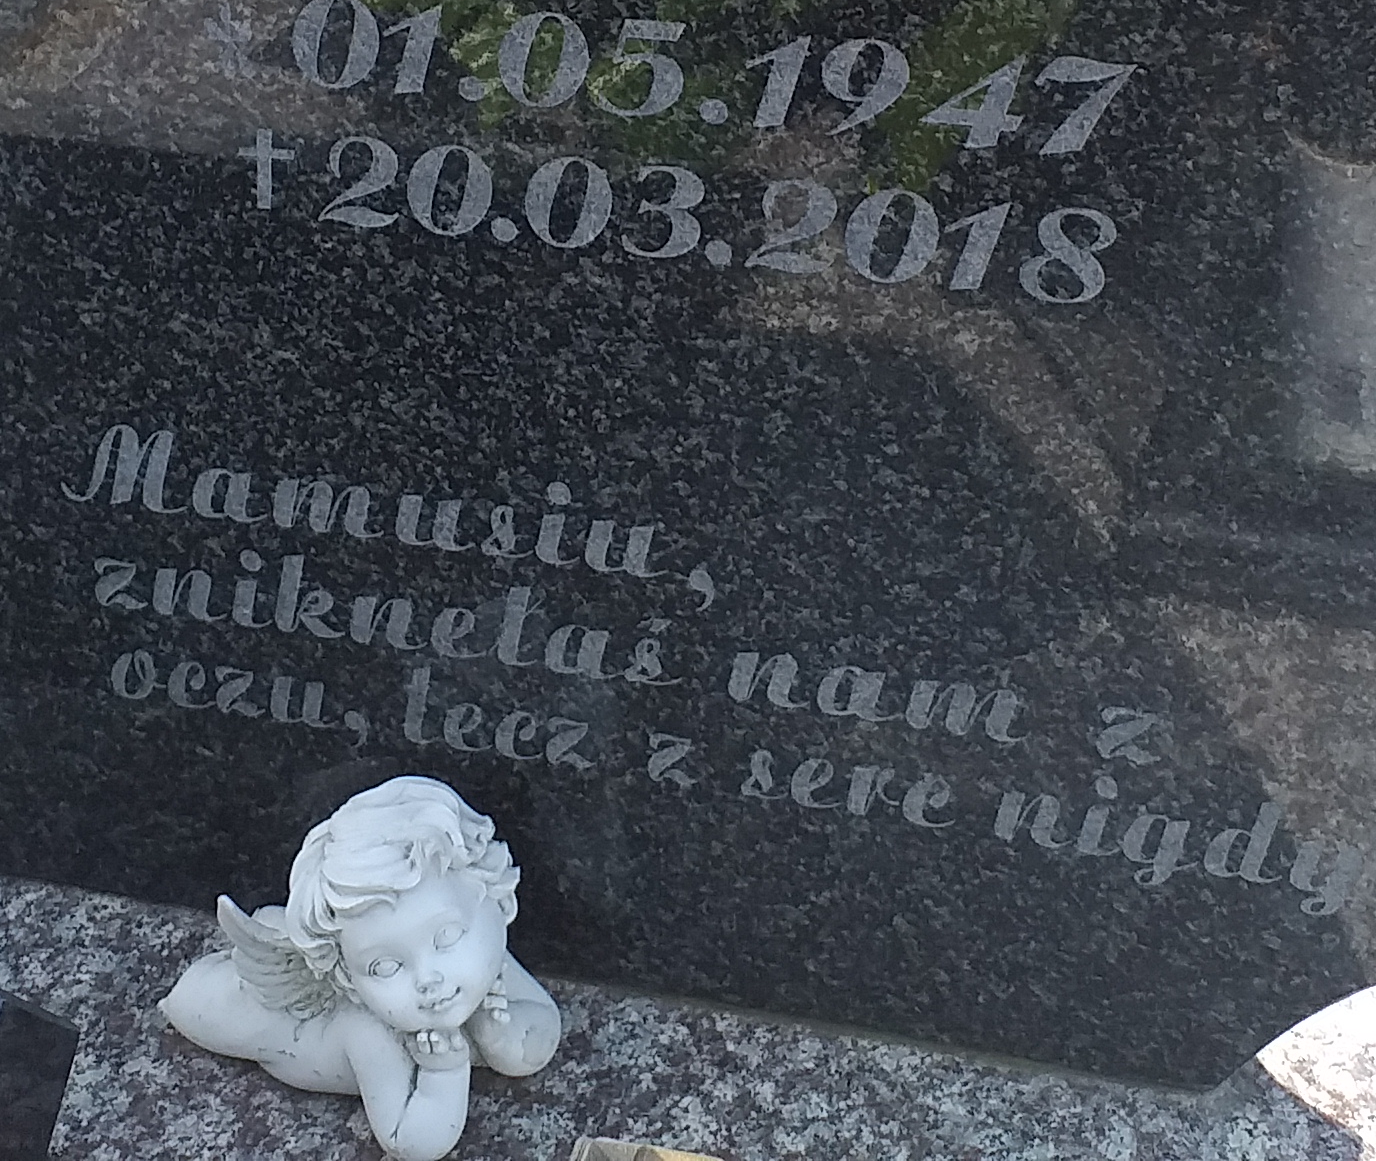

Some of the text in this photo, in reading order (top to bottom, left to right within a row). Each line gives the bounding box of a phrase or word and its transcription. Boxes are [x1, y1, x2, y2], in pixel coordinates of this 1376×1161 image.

[60, 423, 715, 612] Mamusiu,
[110, 649, 1362, 916] oczu, lecz z serc nigdy
[727, 651, 1026, 742] nam
[1094, 706, 1162, 765] z
